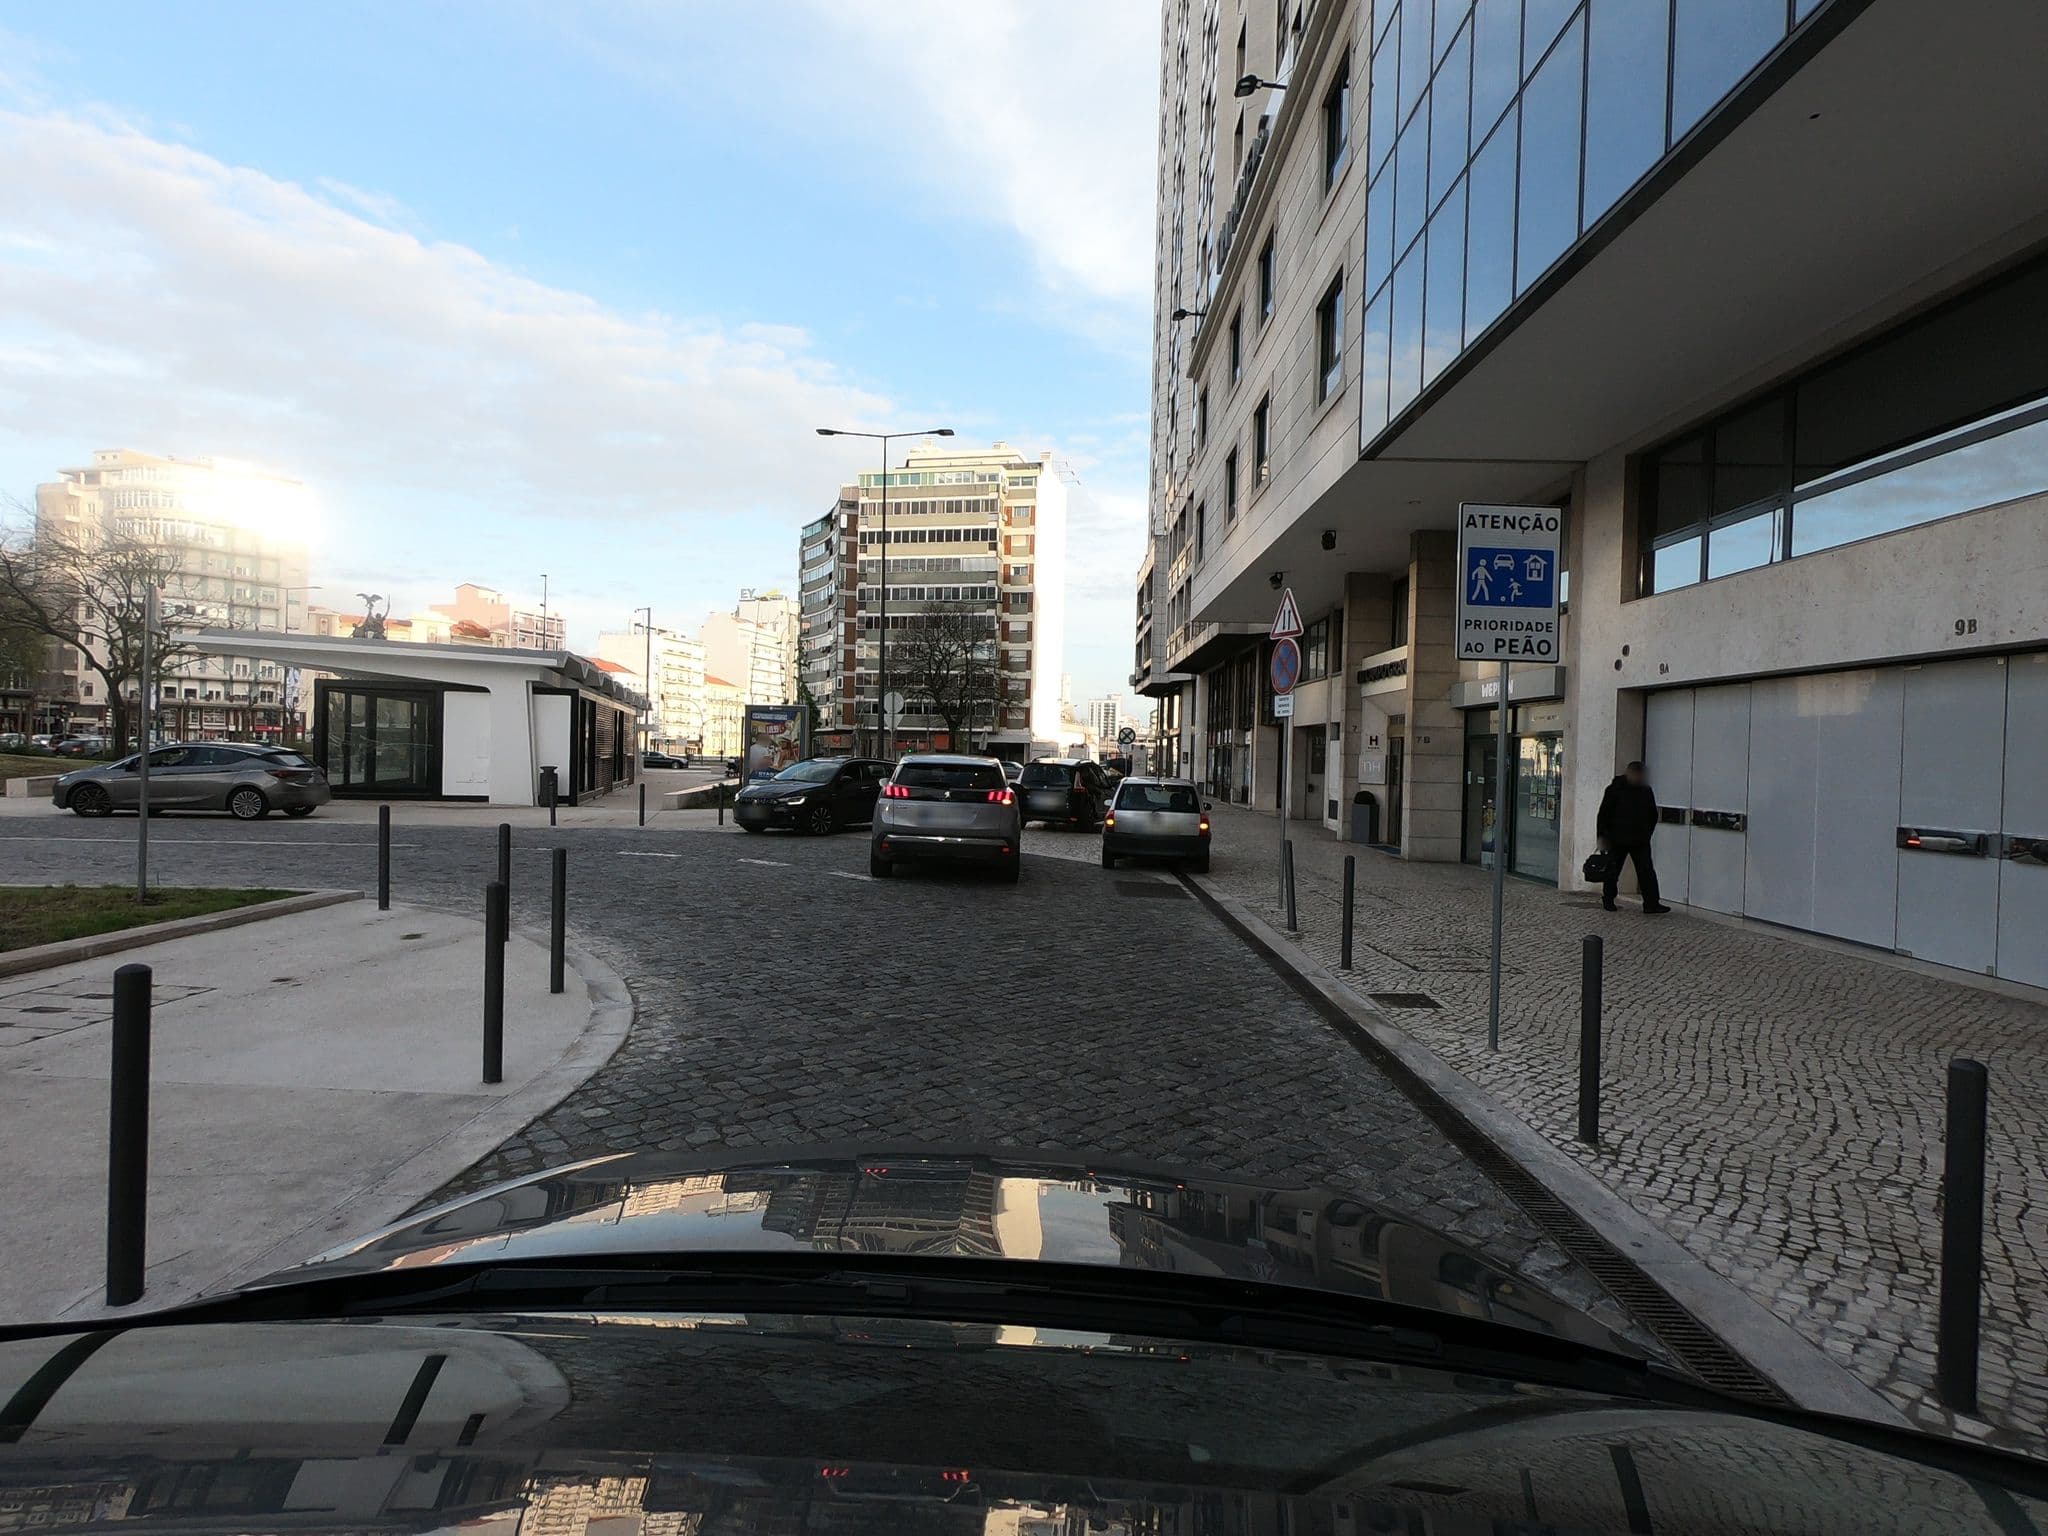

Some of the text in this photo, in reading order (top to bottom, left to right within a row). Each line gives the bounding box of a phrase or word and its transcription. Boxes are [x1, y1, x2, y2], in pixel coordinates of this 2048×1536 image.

[1465, 513, 1559, 535] ATENÇÃO
[741, 588, 756, 599] EY
[1464, 619, 1554, 633] PRIORIDADE
[1954, 618, 1978, 636] 9B
[1464, 635, 1552, 656] AO PEÃO
